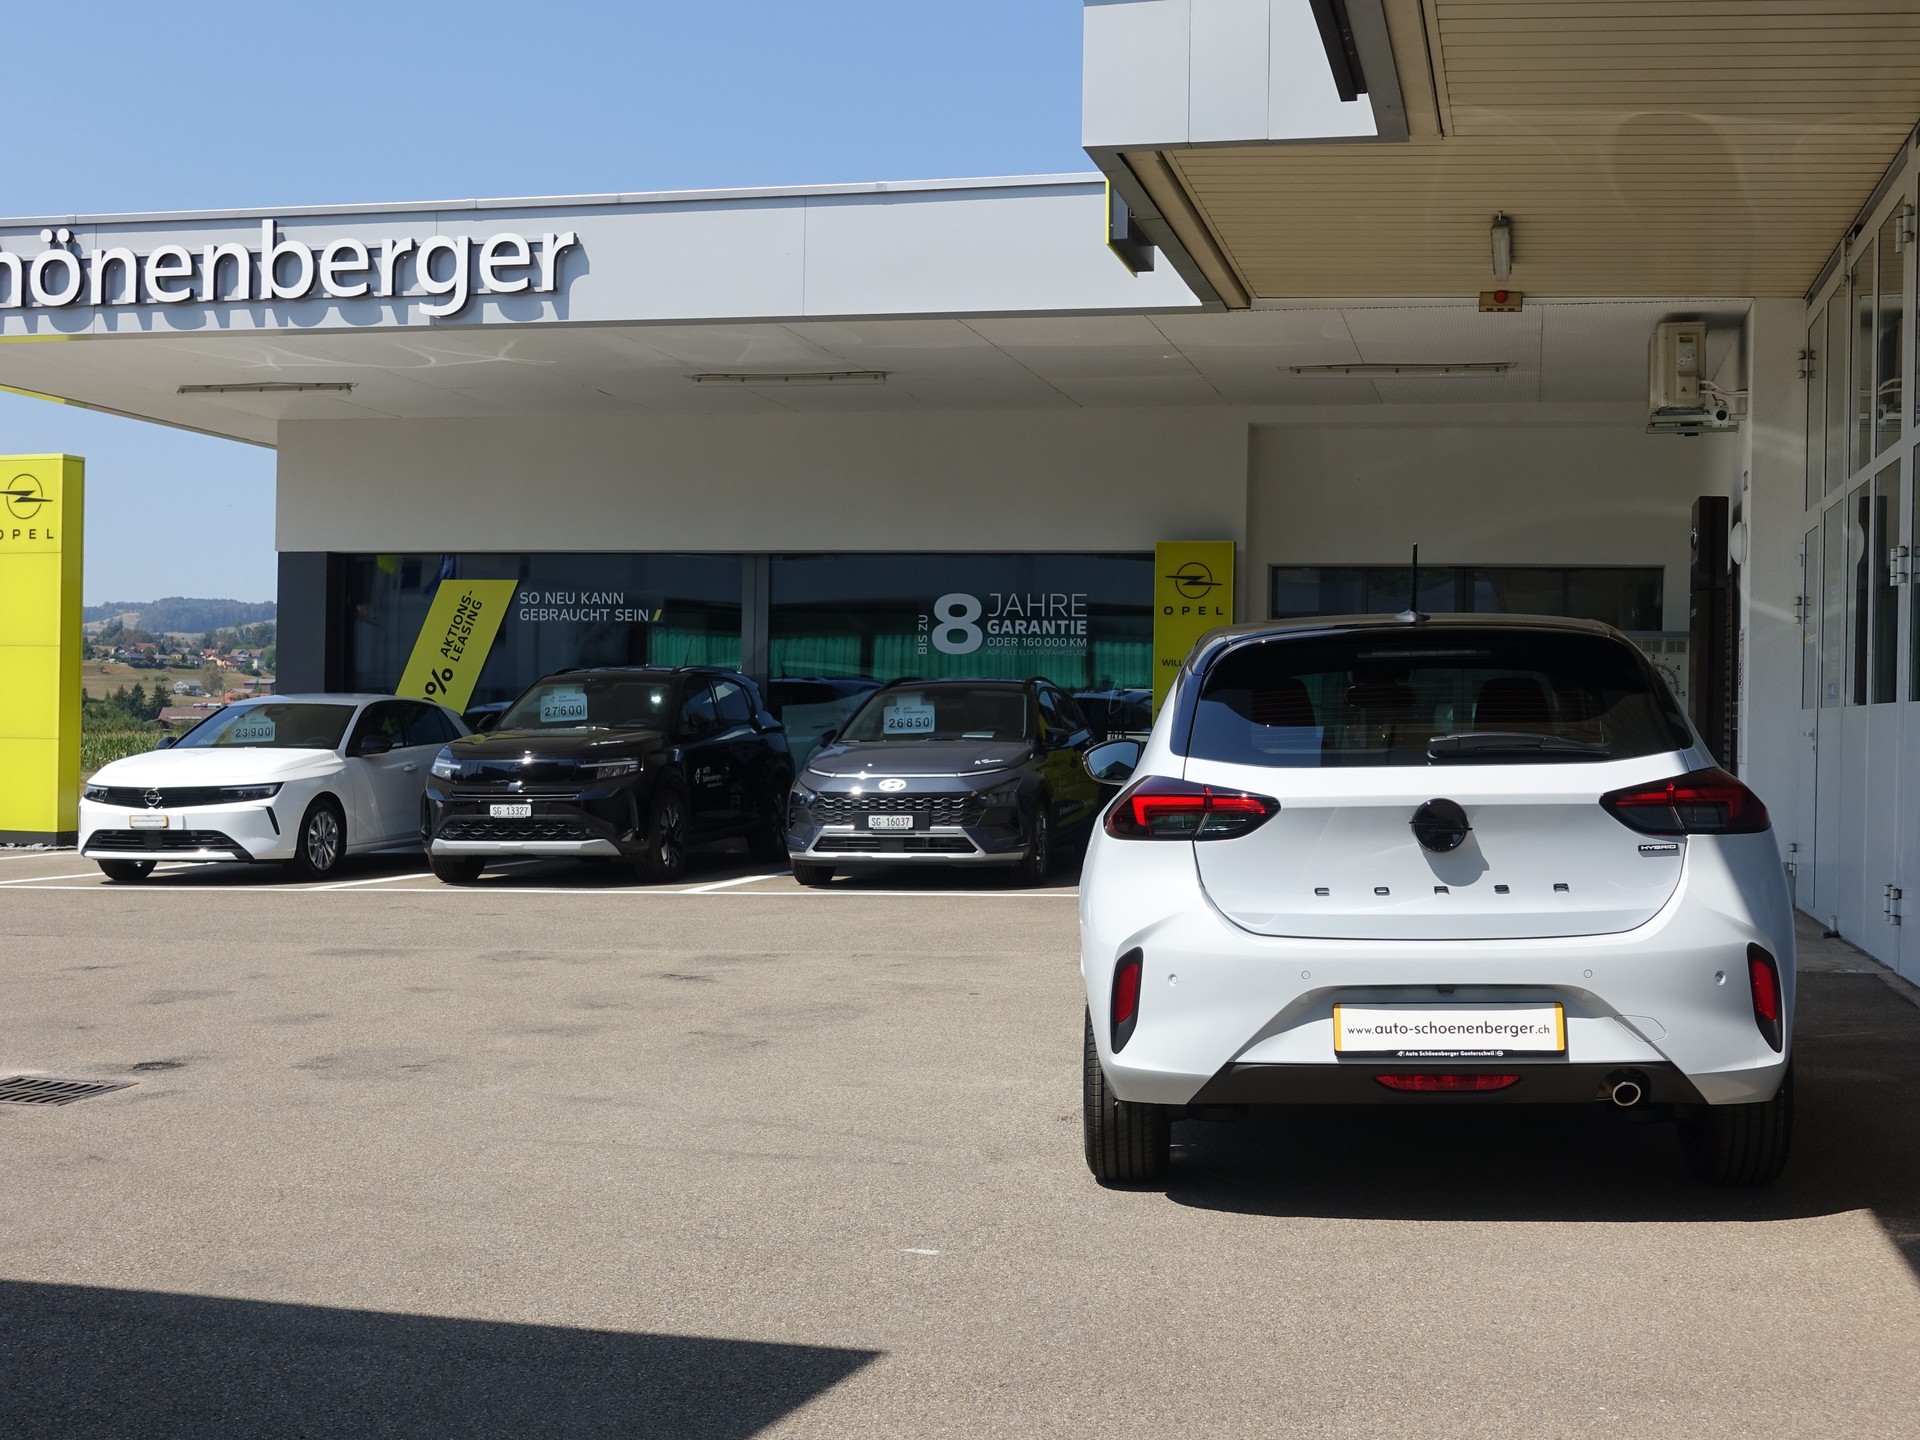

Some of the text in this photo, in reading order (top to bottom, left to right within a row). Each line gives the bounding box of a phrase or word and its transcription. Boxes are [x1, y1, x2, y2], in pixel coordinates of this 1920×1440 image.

[519, 591, 625, 605] SO NEU KANN
[987, 593, 1088, 617] JAHRE
[519, 608, 650, 622] GEBRAUCHT SEIN
[1163, 605, 1224, 616] OPEL
[440, 590, 473, 658] AKTIONS-
[931, 592, 984, 655] 8
[987, 619, 1087, 635] GARANTIE
[449, 599, 483, 663] LEASING
[917, 614, 929, 655] BIS ZU
[987, 637, 1019, 647] ODER
[1069, 638, 1087, 647] KM
[544, 705, 583, 717] 27600
[888, 717, 930, 728] 26850
[492, 806, 529, 815] SG 13327
[871, 817, 910, 826] SG 16037
[1314, 883, 1570, 897] CORSA
[1347, 1021, 1550, 1038] www.auto-schoenenberger.ch
[1419, 1050, 1459, 1058] Schönenberger
